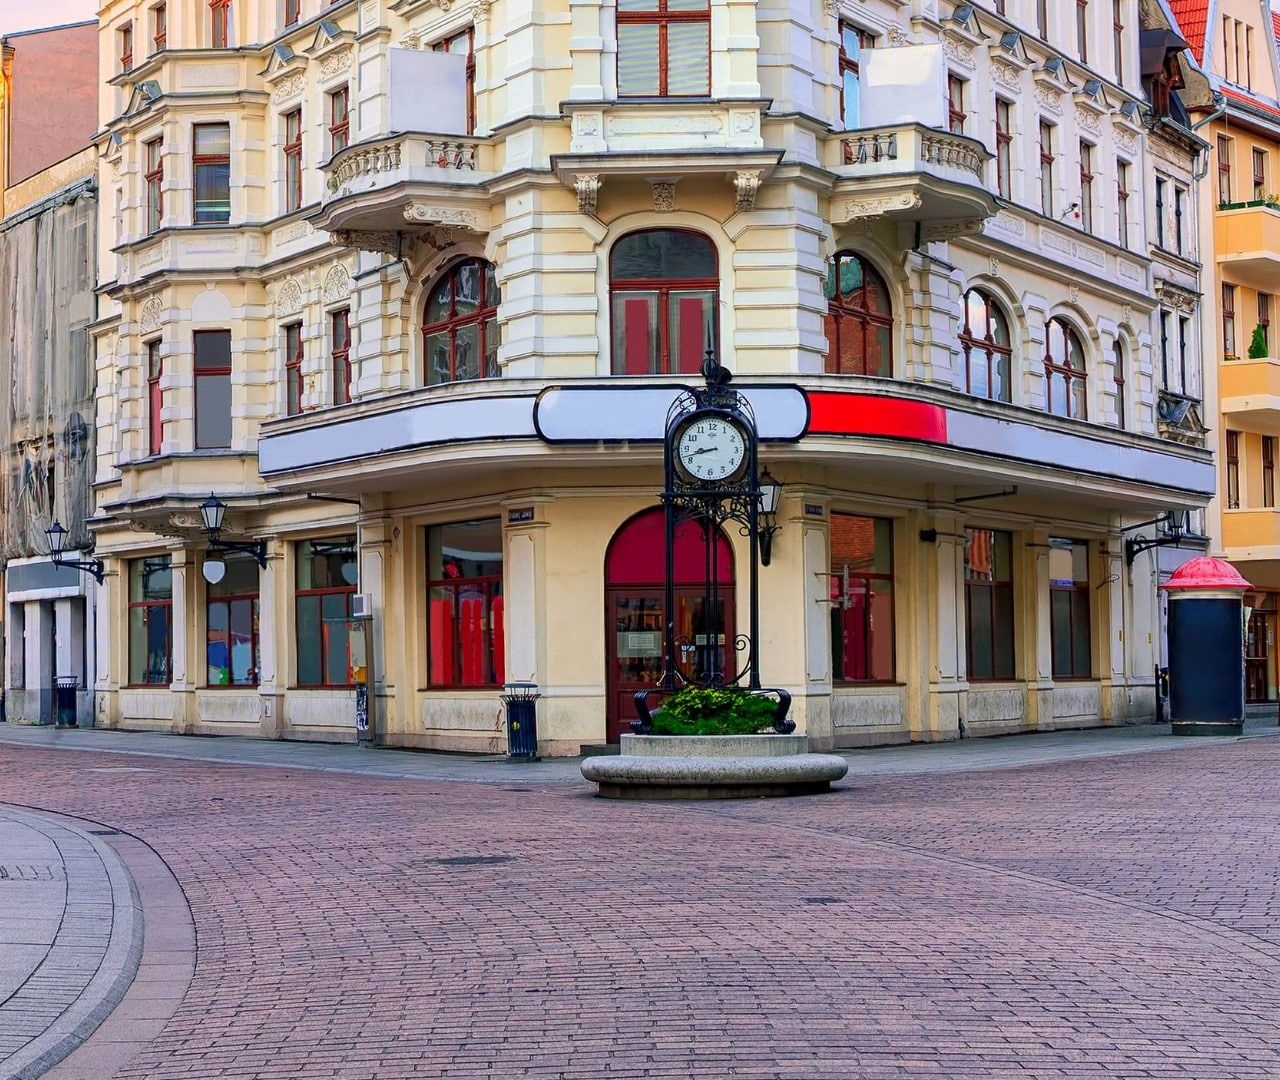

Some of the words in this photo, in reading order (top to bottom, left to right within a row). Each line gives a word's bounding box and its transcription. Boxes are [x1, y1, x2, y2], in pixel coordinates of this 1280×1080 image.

[708, 423, 717, 431] 12
[688, 434, 697, 442] 10
[734, 446, 739, 454] 3
